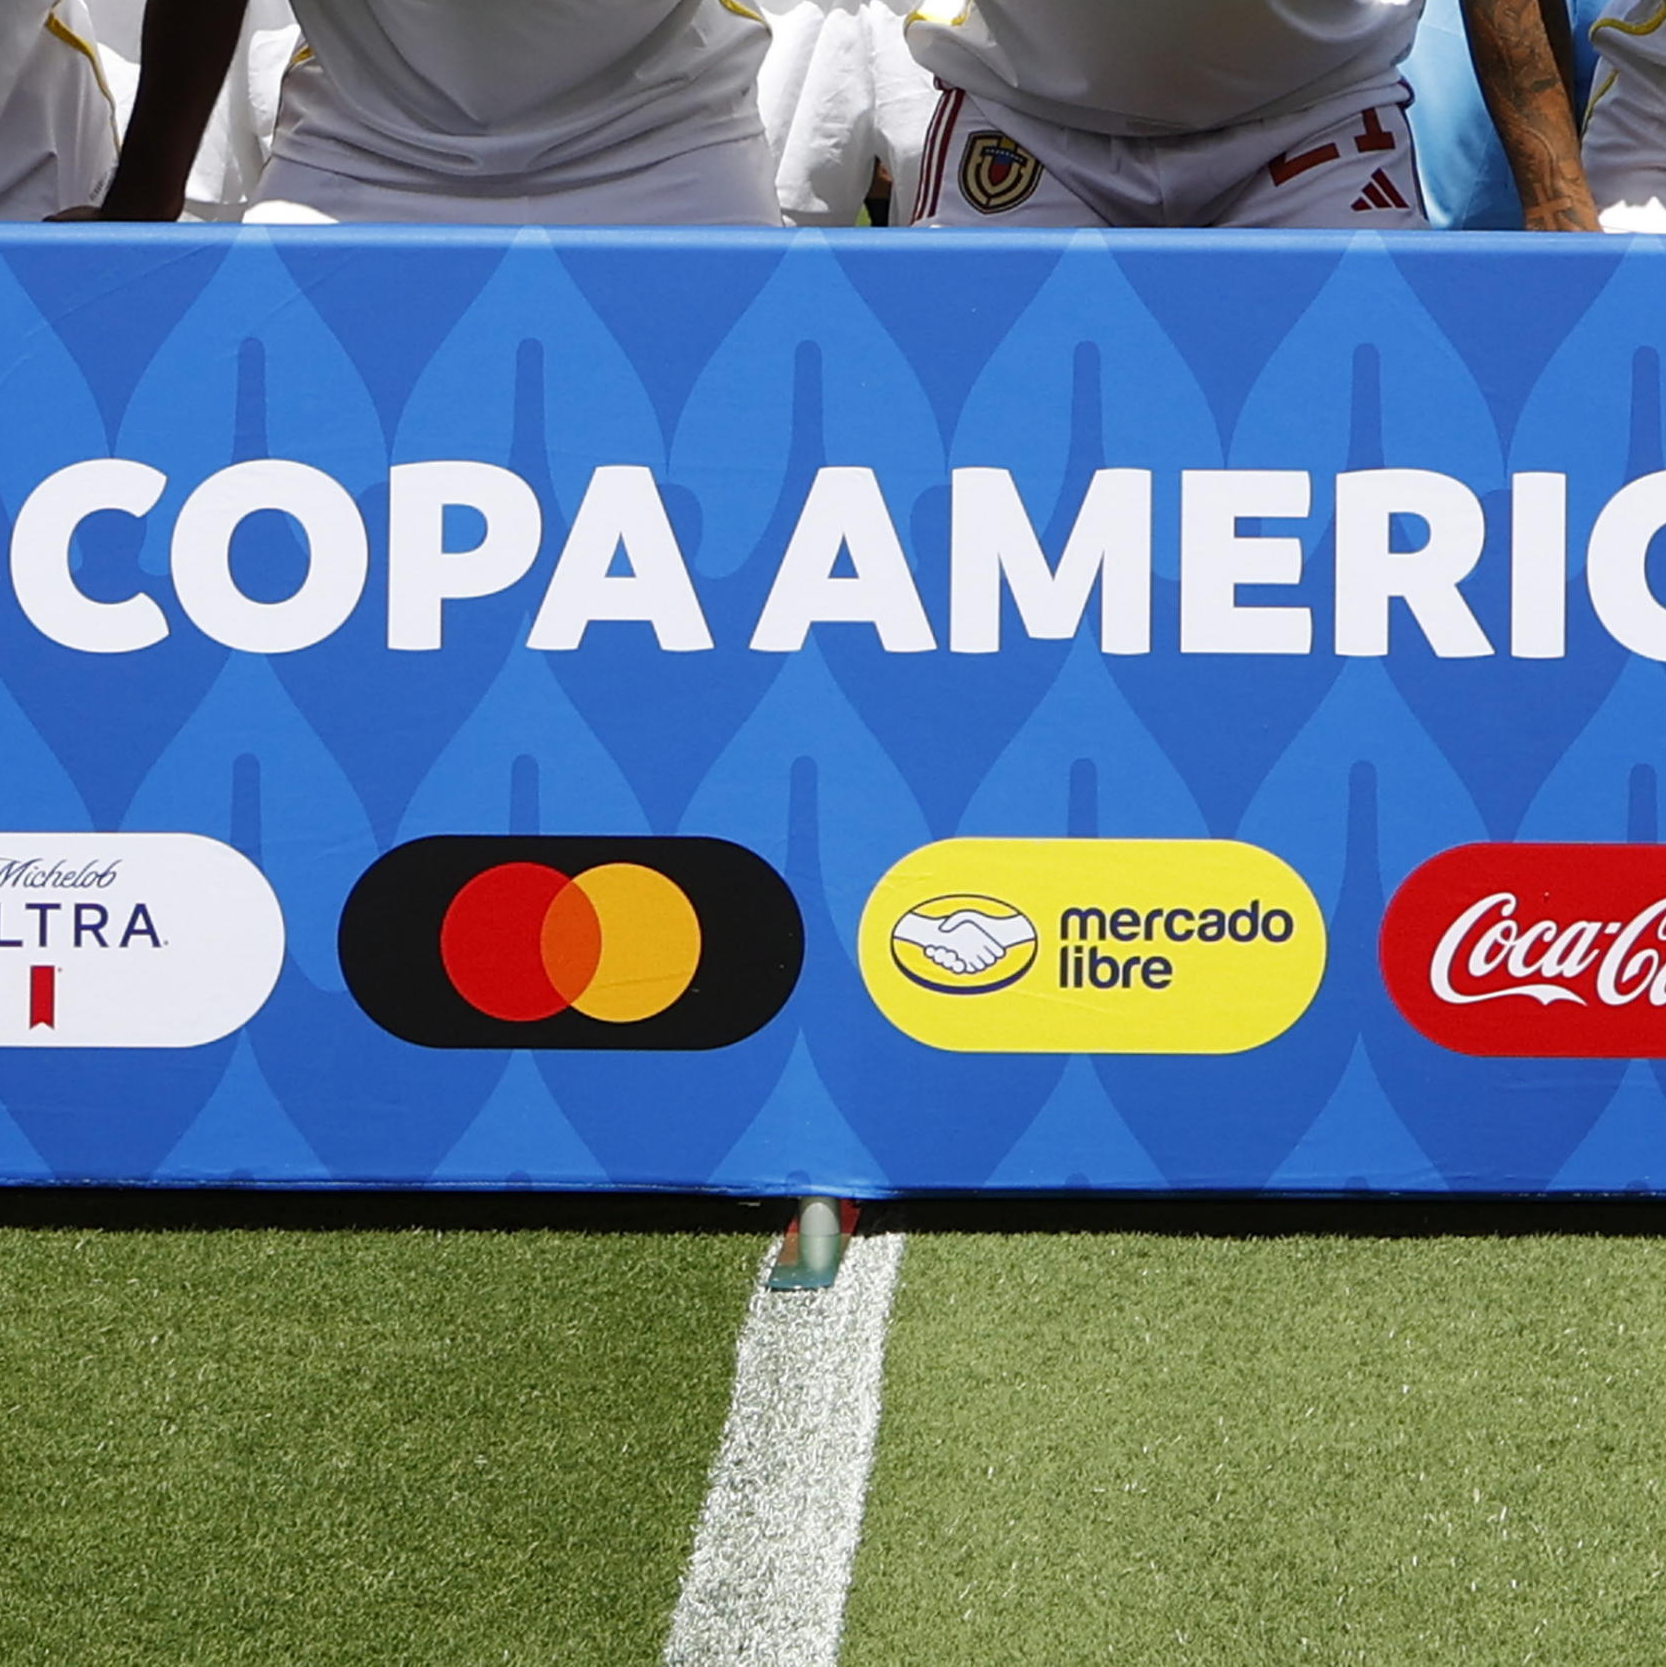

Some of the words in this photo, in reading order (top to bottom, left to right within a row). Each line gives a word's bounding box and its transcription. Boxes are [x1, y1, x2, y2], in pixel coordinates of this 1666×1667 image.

[9, 458, 715, 654] COPA
[1058, 898, 1295, 944] mercado
[1058, 946, 1174, 990] libre
